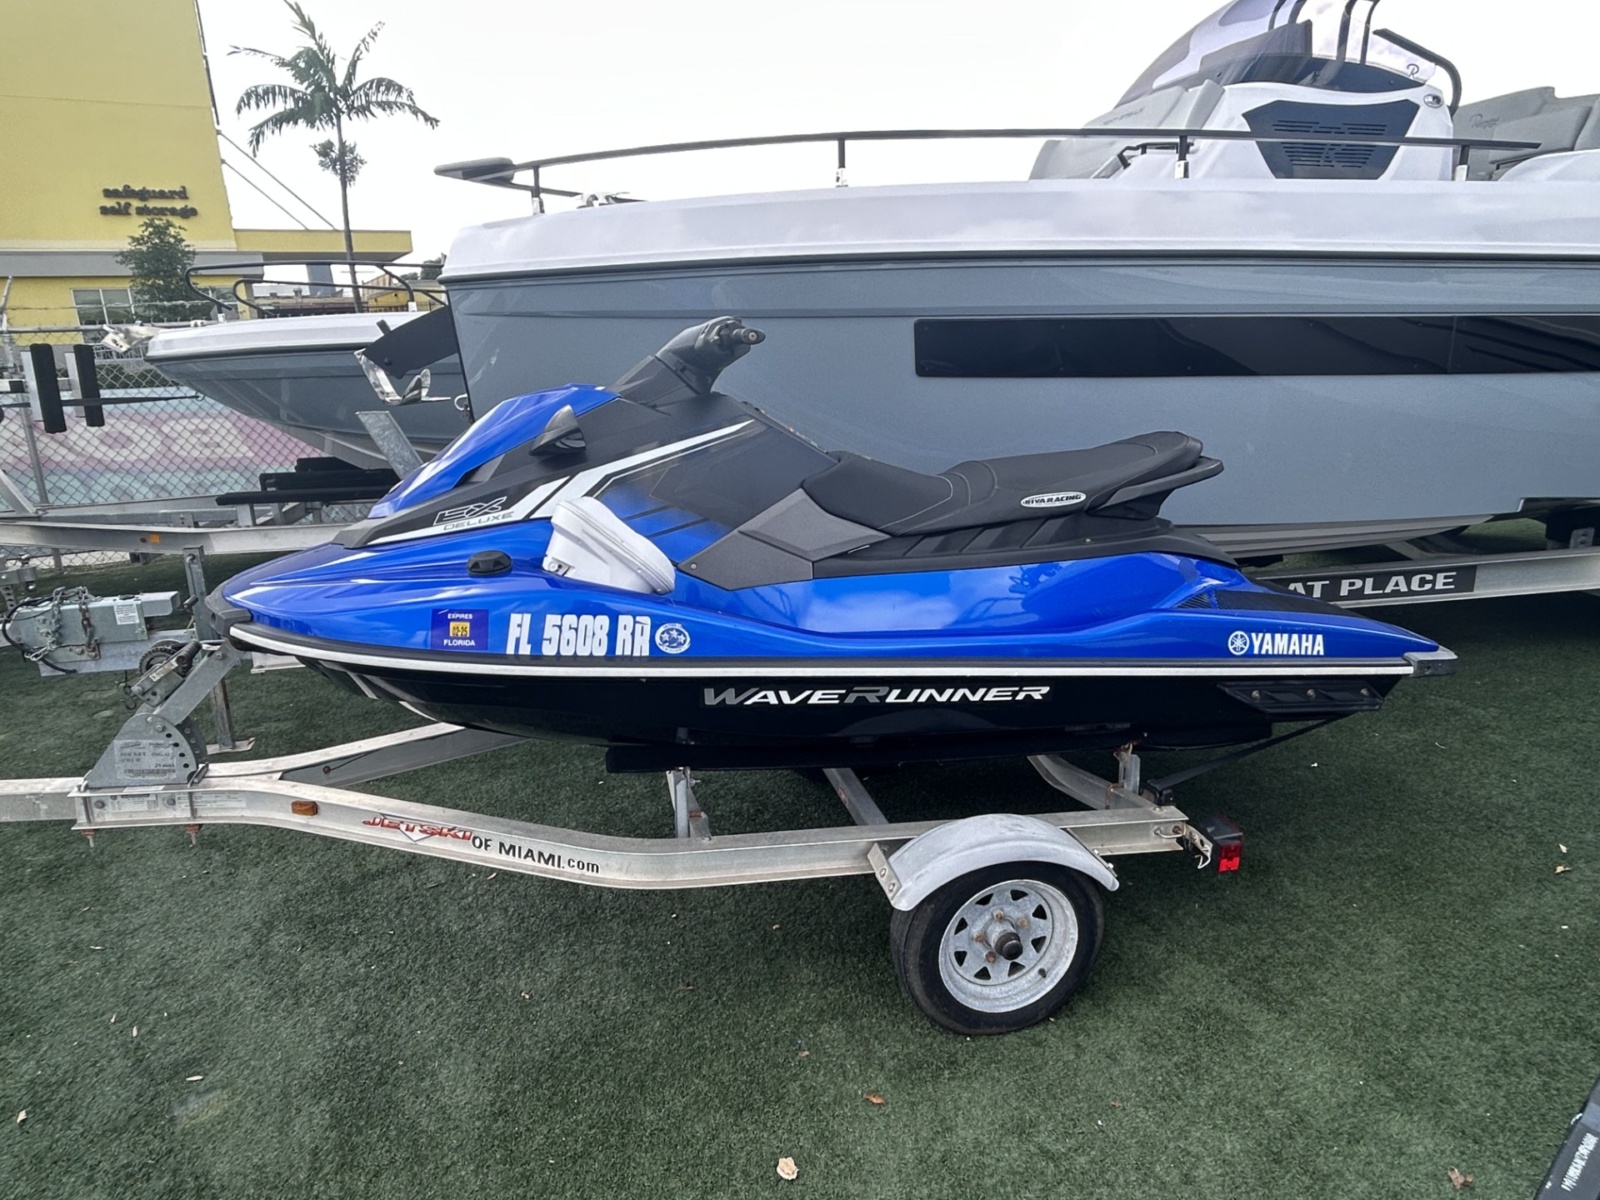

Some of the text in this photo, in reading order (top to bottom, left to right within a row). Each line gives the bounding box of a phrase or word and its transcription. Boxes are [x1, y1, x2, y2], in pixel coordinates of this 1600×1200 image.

[1046, 494, 1082, 504] RACING
[432, 496, 508, 526] EX
[443, 510, 516, 531] DELUXE
[1339, 571, 1457, 597] PLACE
[446, 612, 474, 620] EXPIRES
[506, 613, 532, 656] FL
[541, 614, 610, 657] 5608
[1251, 632, 1325, 656] YAMAHA
[472, 835, 493, 852] OF
